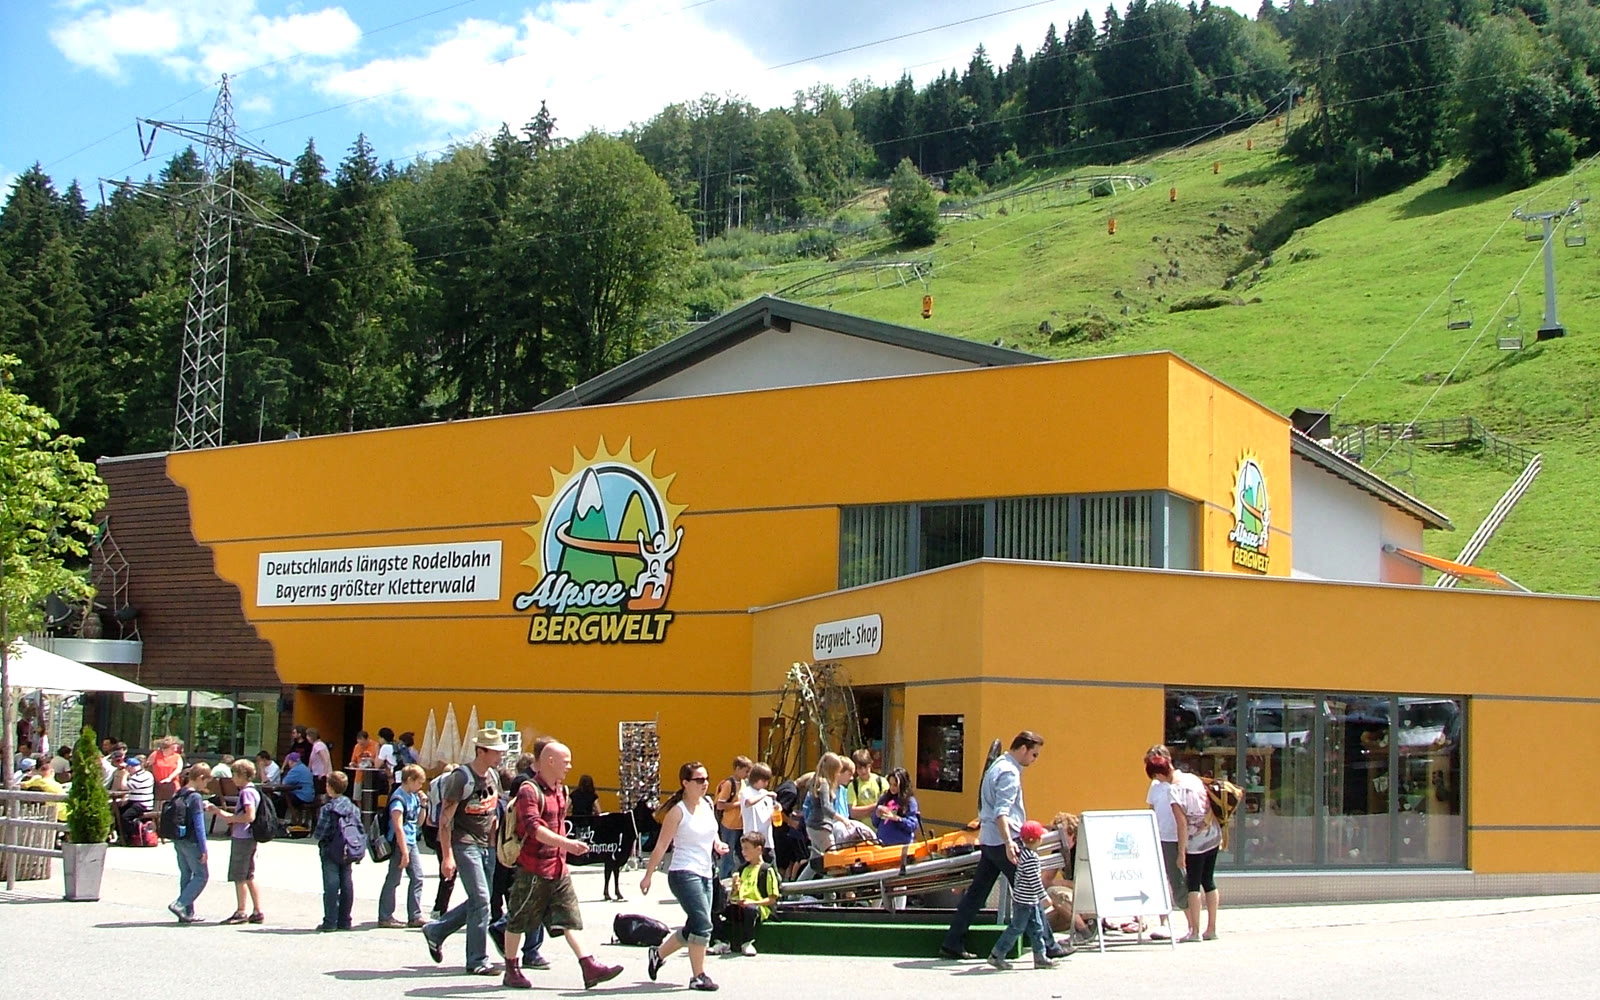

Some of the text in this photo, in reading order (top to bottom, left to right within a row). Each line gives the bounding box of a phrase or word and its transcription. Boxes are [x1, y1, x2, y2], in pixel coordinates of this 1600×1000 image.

[266, 549, 491, 577] Deutschlands längste Rodelbahn
[1233, 547, 1270, 573] BERGWELT
[276, 576, 476, 602] Bayerns größter Kletterwald
[514, 572, 627, 614] Alpsee
[530, 613, 673, 643] BERGWELT
